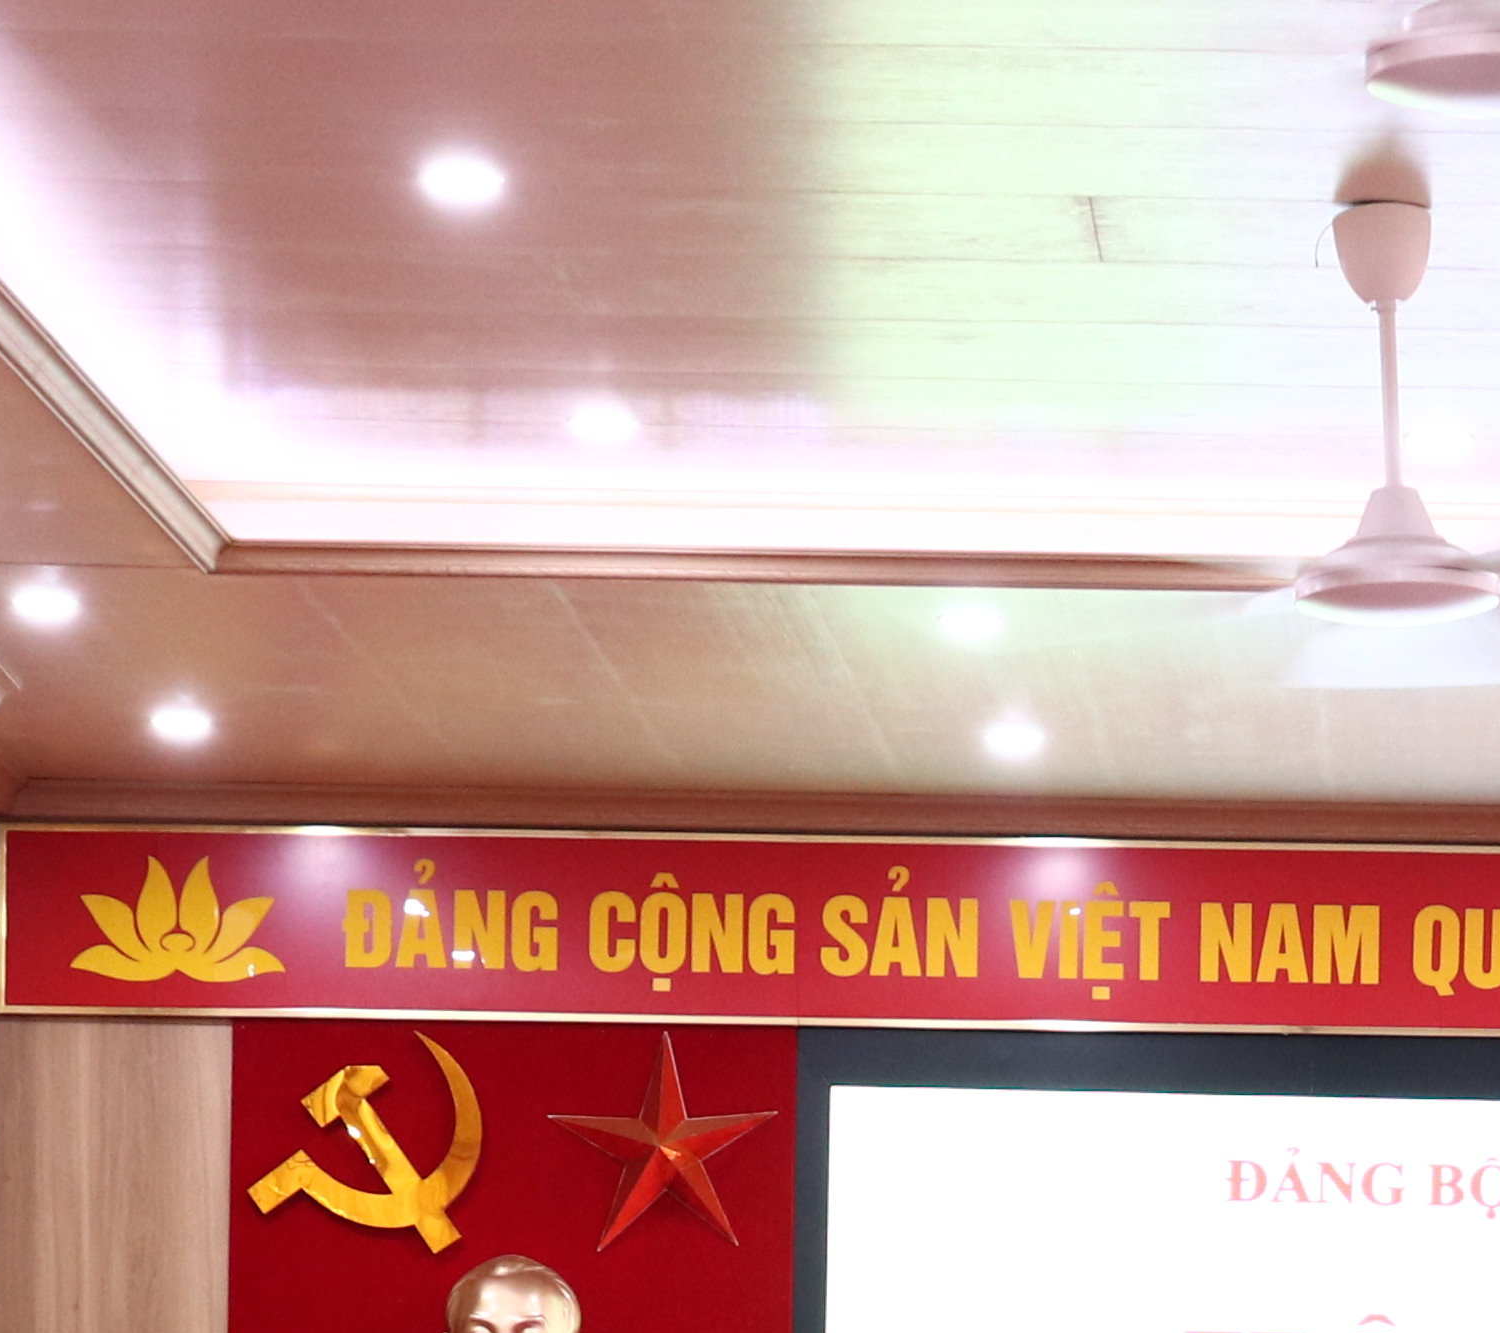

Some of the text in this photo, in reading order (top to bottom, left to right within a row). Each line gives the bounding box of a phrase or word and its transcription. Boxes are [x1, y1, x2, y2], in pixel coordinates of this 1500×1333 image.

[341, 858, 558, 972] ĐẢNG
[590, 874, 794, 992] CỘNG
[821, 866, 979, 978] SẢN
[1010, 881, 1171, 1000] VIỆT
[1200, 902, 1380, 985] NAM
[1226, 1146, 1406, 1207] ĐẢNG
